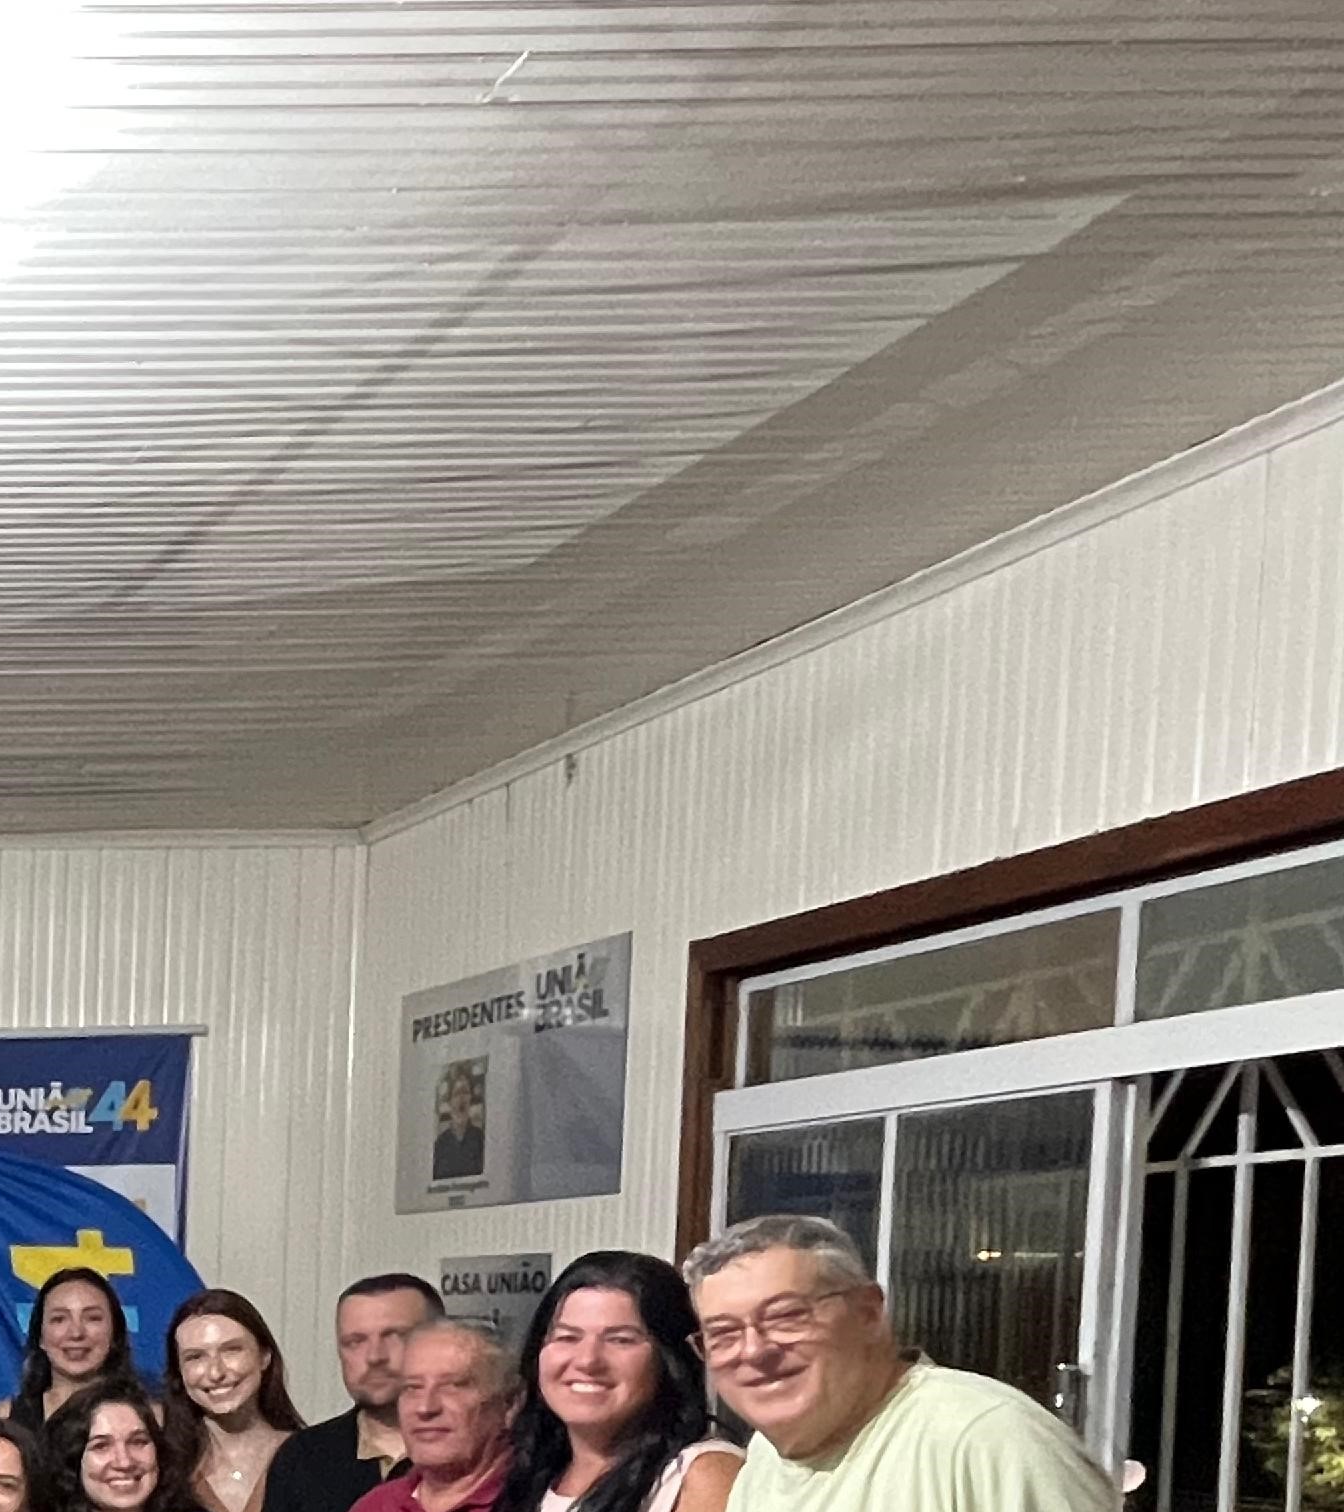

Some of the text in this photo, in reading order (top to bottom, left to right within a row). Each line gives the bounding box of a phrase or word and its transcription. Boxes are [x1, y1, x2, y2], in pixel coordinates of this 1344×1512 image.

[412, 990, 526, 1043] PRESIDENTES
[88, 1079, 159, 1132] 44
[441, 1261, 546, 1296] CASA UNIÃO
